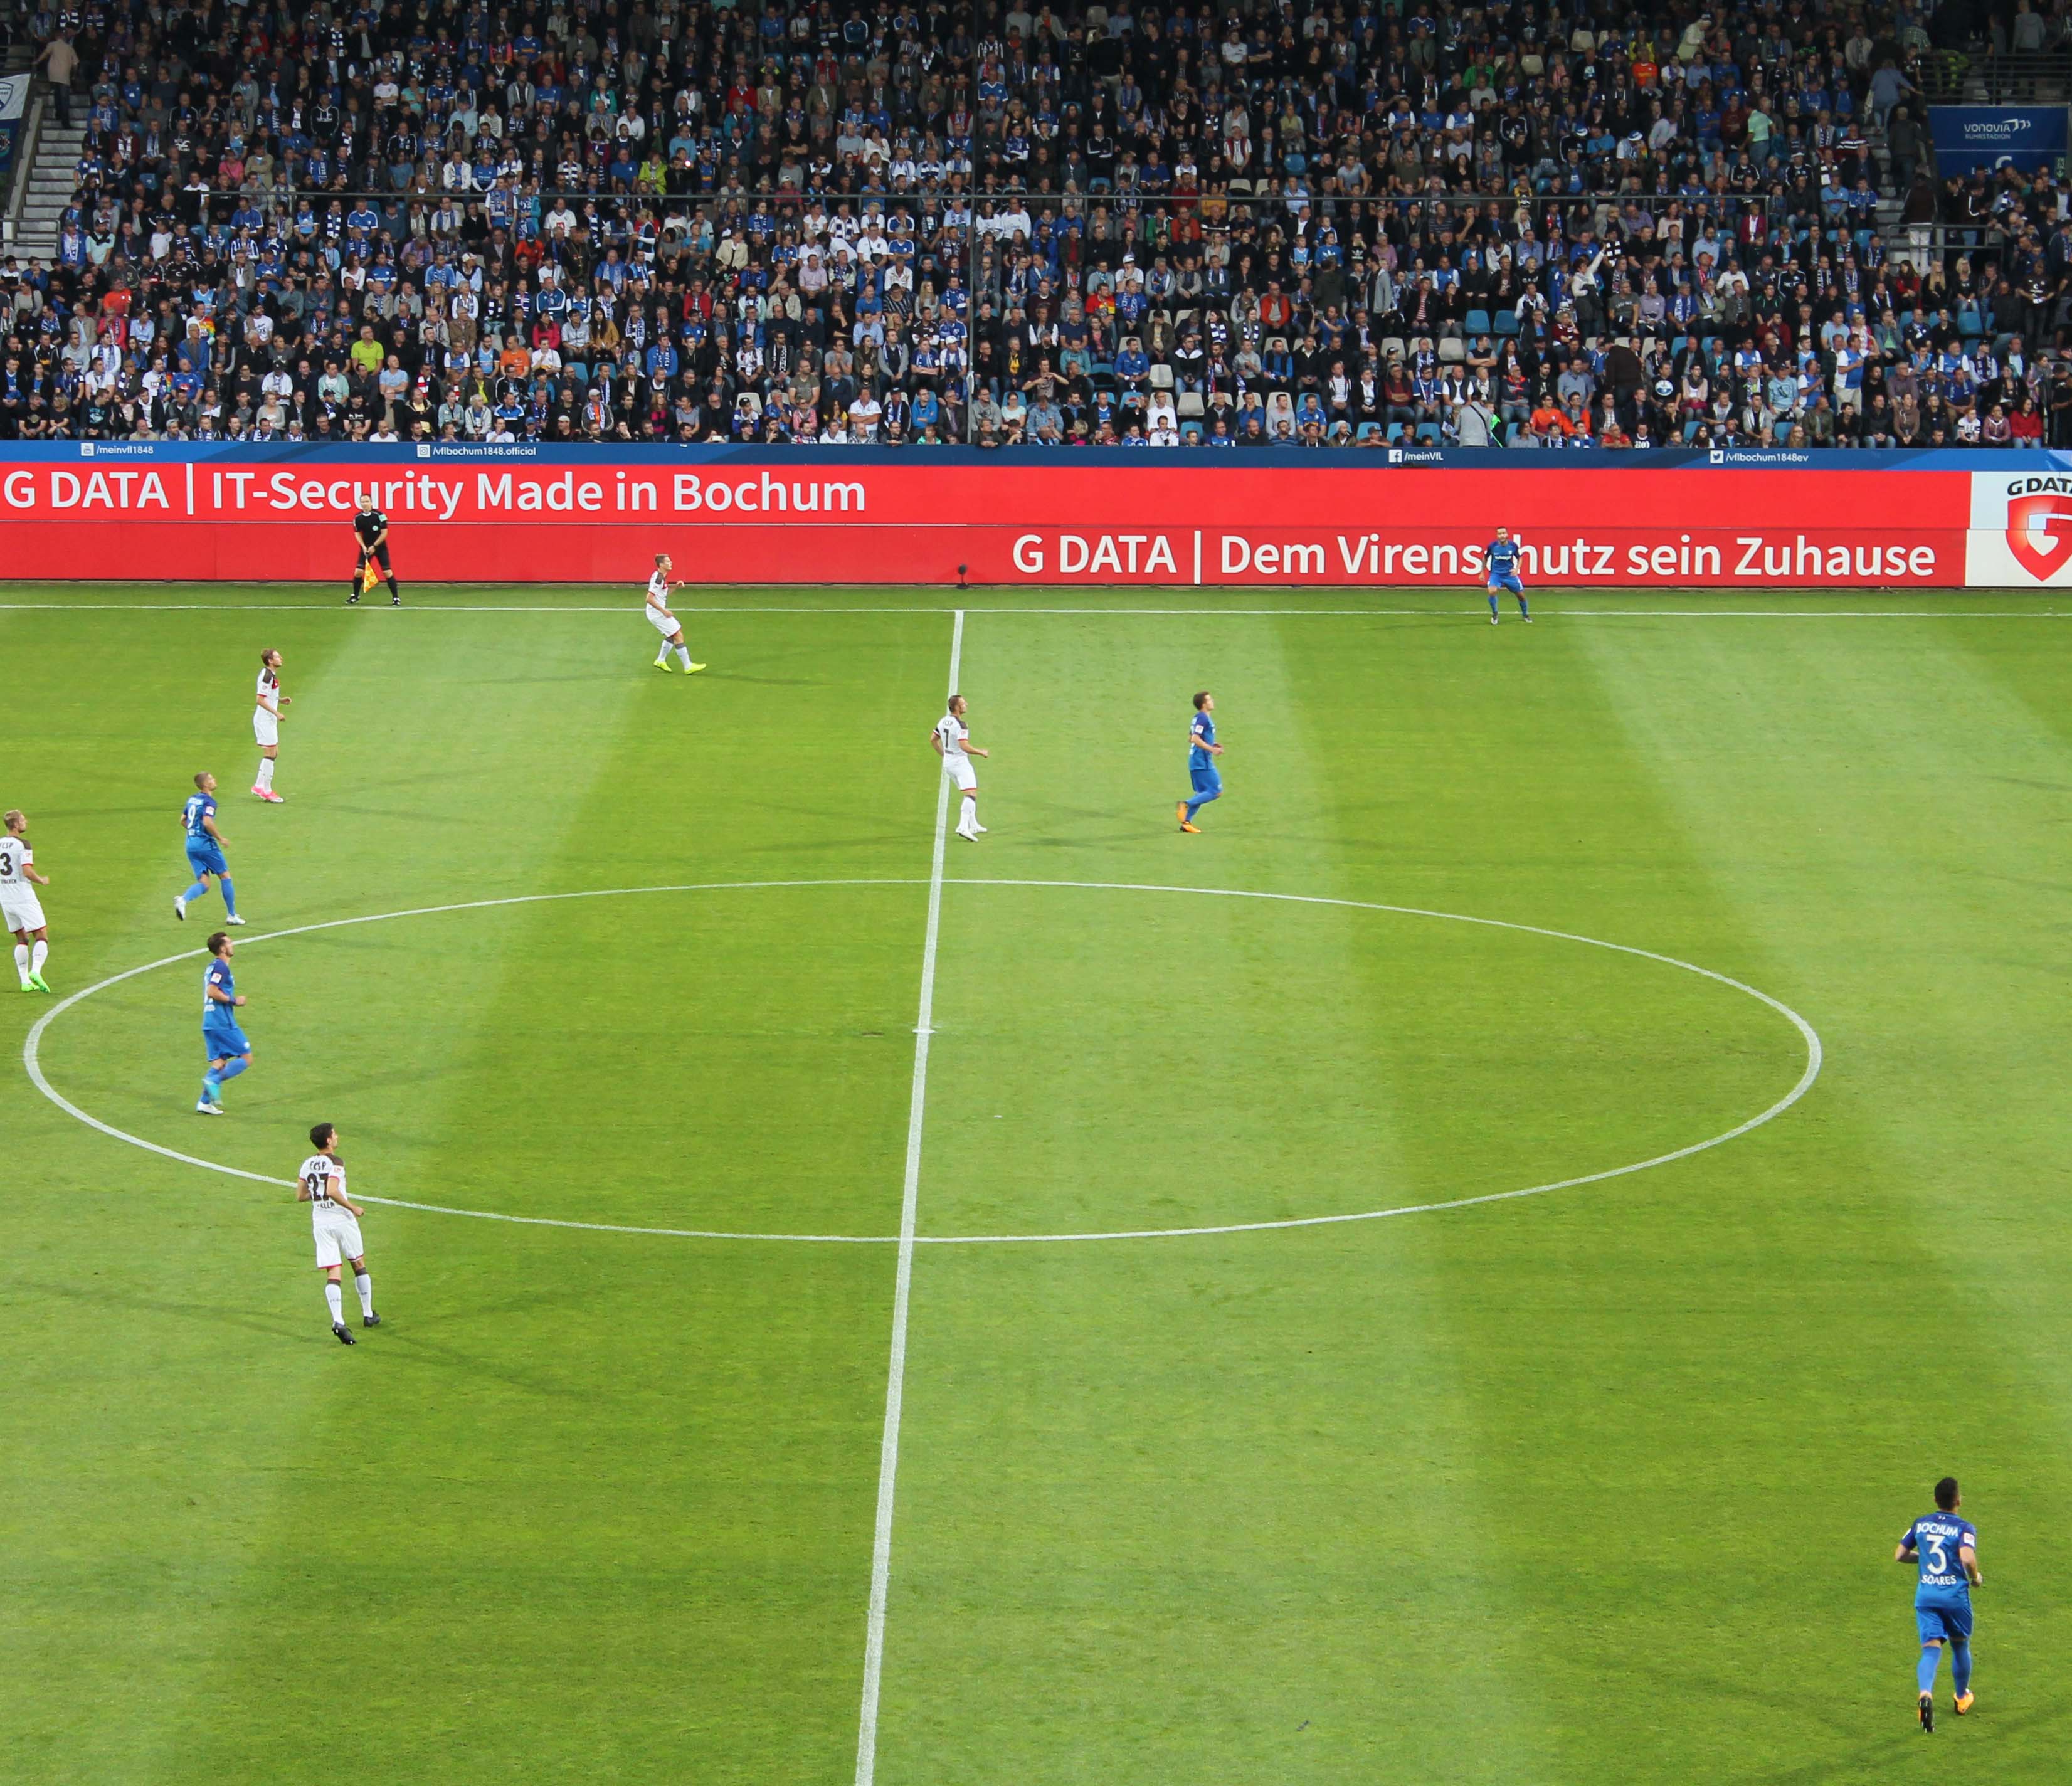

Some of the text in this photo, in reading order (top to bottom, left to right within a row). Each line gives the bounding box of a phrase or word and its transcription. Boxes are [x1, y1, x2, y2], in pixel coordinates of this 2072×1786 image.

[96, 445, 154, 454] /meinvfl1848
[433, 446, 536, 456] /vflbochum1848.official
[1404, 452, 1444, 460] /meinVfL
[1726, 453, 1809, 462] /vflbochum1848ev
[4, 470, 865, 520] G DATA IT-Security Made in Bochum
[1012, 533, 1935, 576] G DATA Dem Virenshutz sein Zuhause
[1916, 1522, 1958, 1536] BOCHUM
[1926, 1534, 1947, 1575] 3
[1921, 1574, 1957, 1585] SOARES
